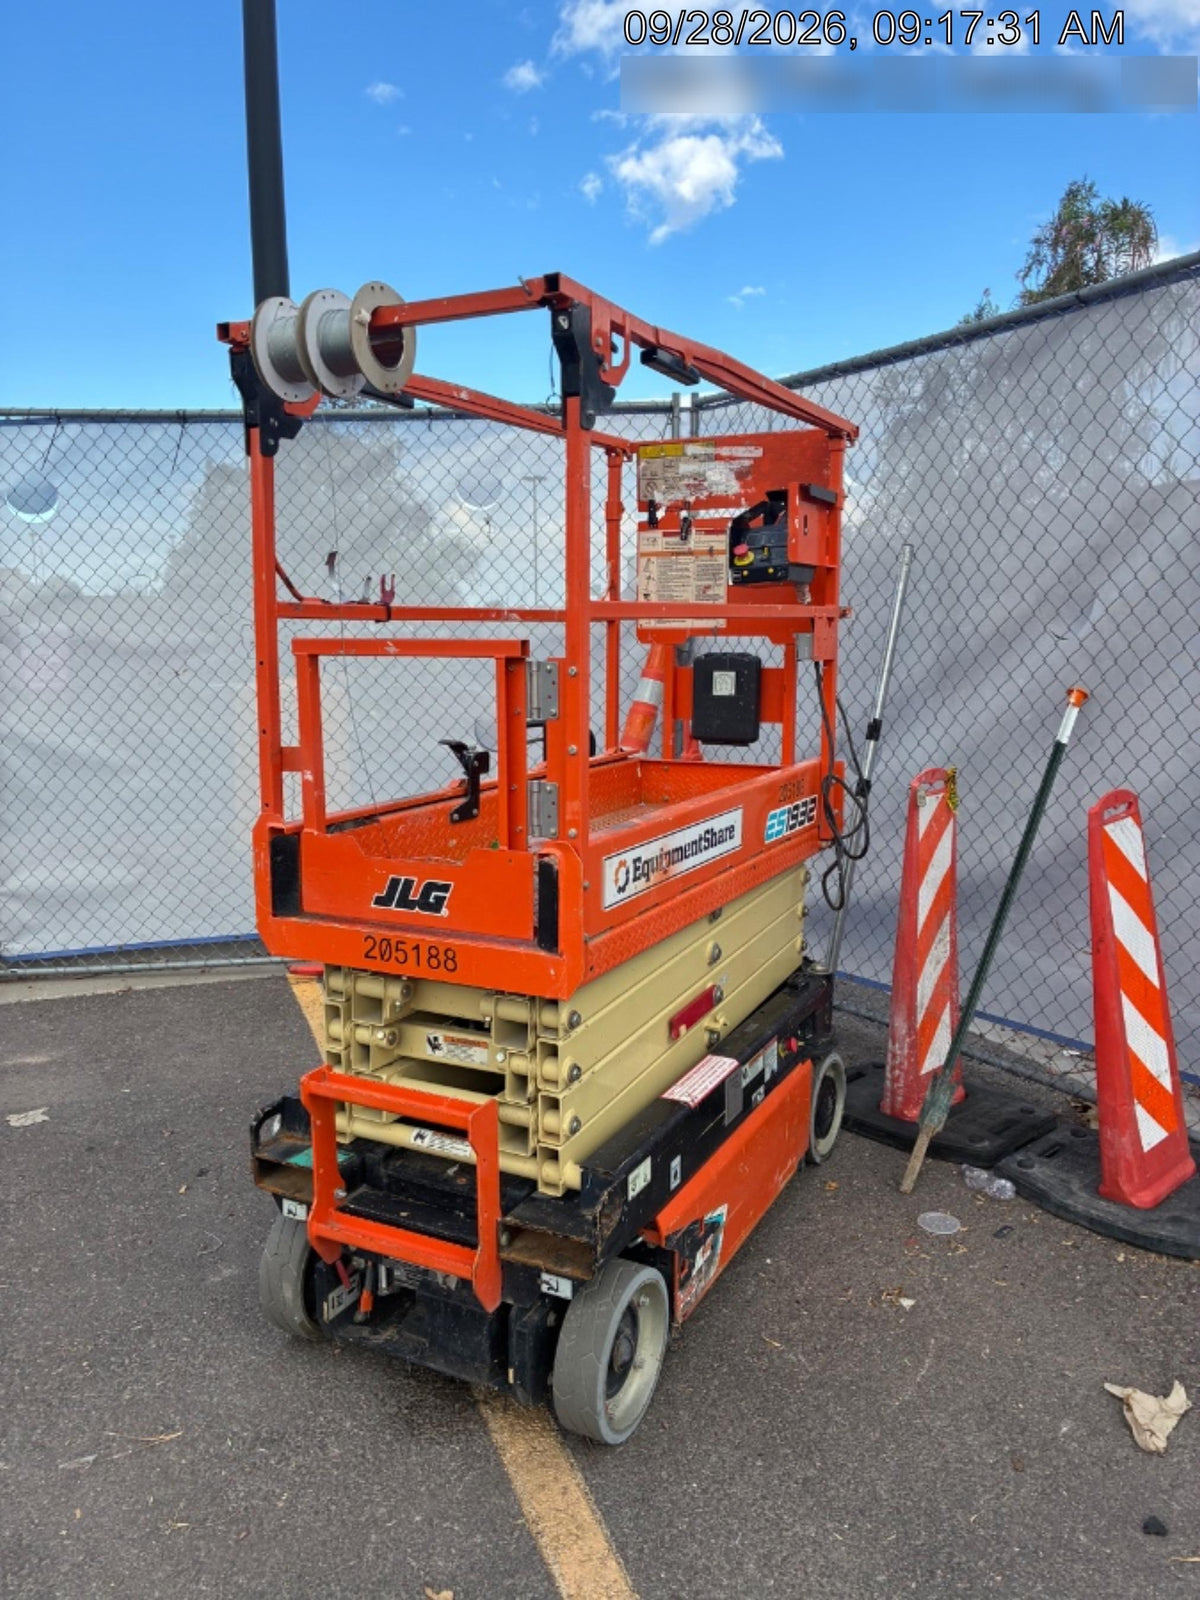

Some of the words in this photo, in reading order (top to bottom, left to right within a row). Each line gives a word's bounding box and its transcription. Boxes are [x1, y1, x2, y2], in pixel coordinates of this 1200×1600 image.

[765, 795, 817, 842] ES1932
[632, 824, 735, 882] EquipmentShare
[371, 874, 454, 916] JLG
[363, 934, 458, 973] 205188
